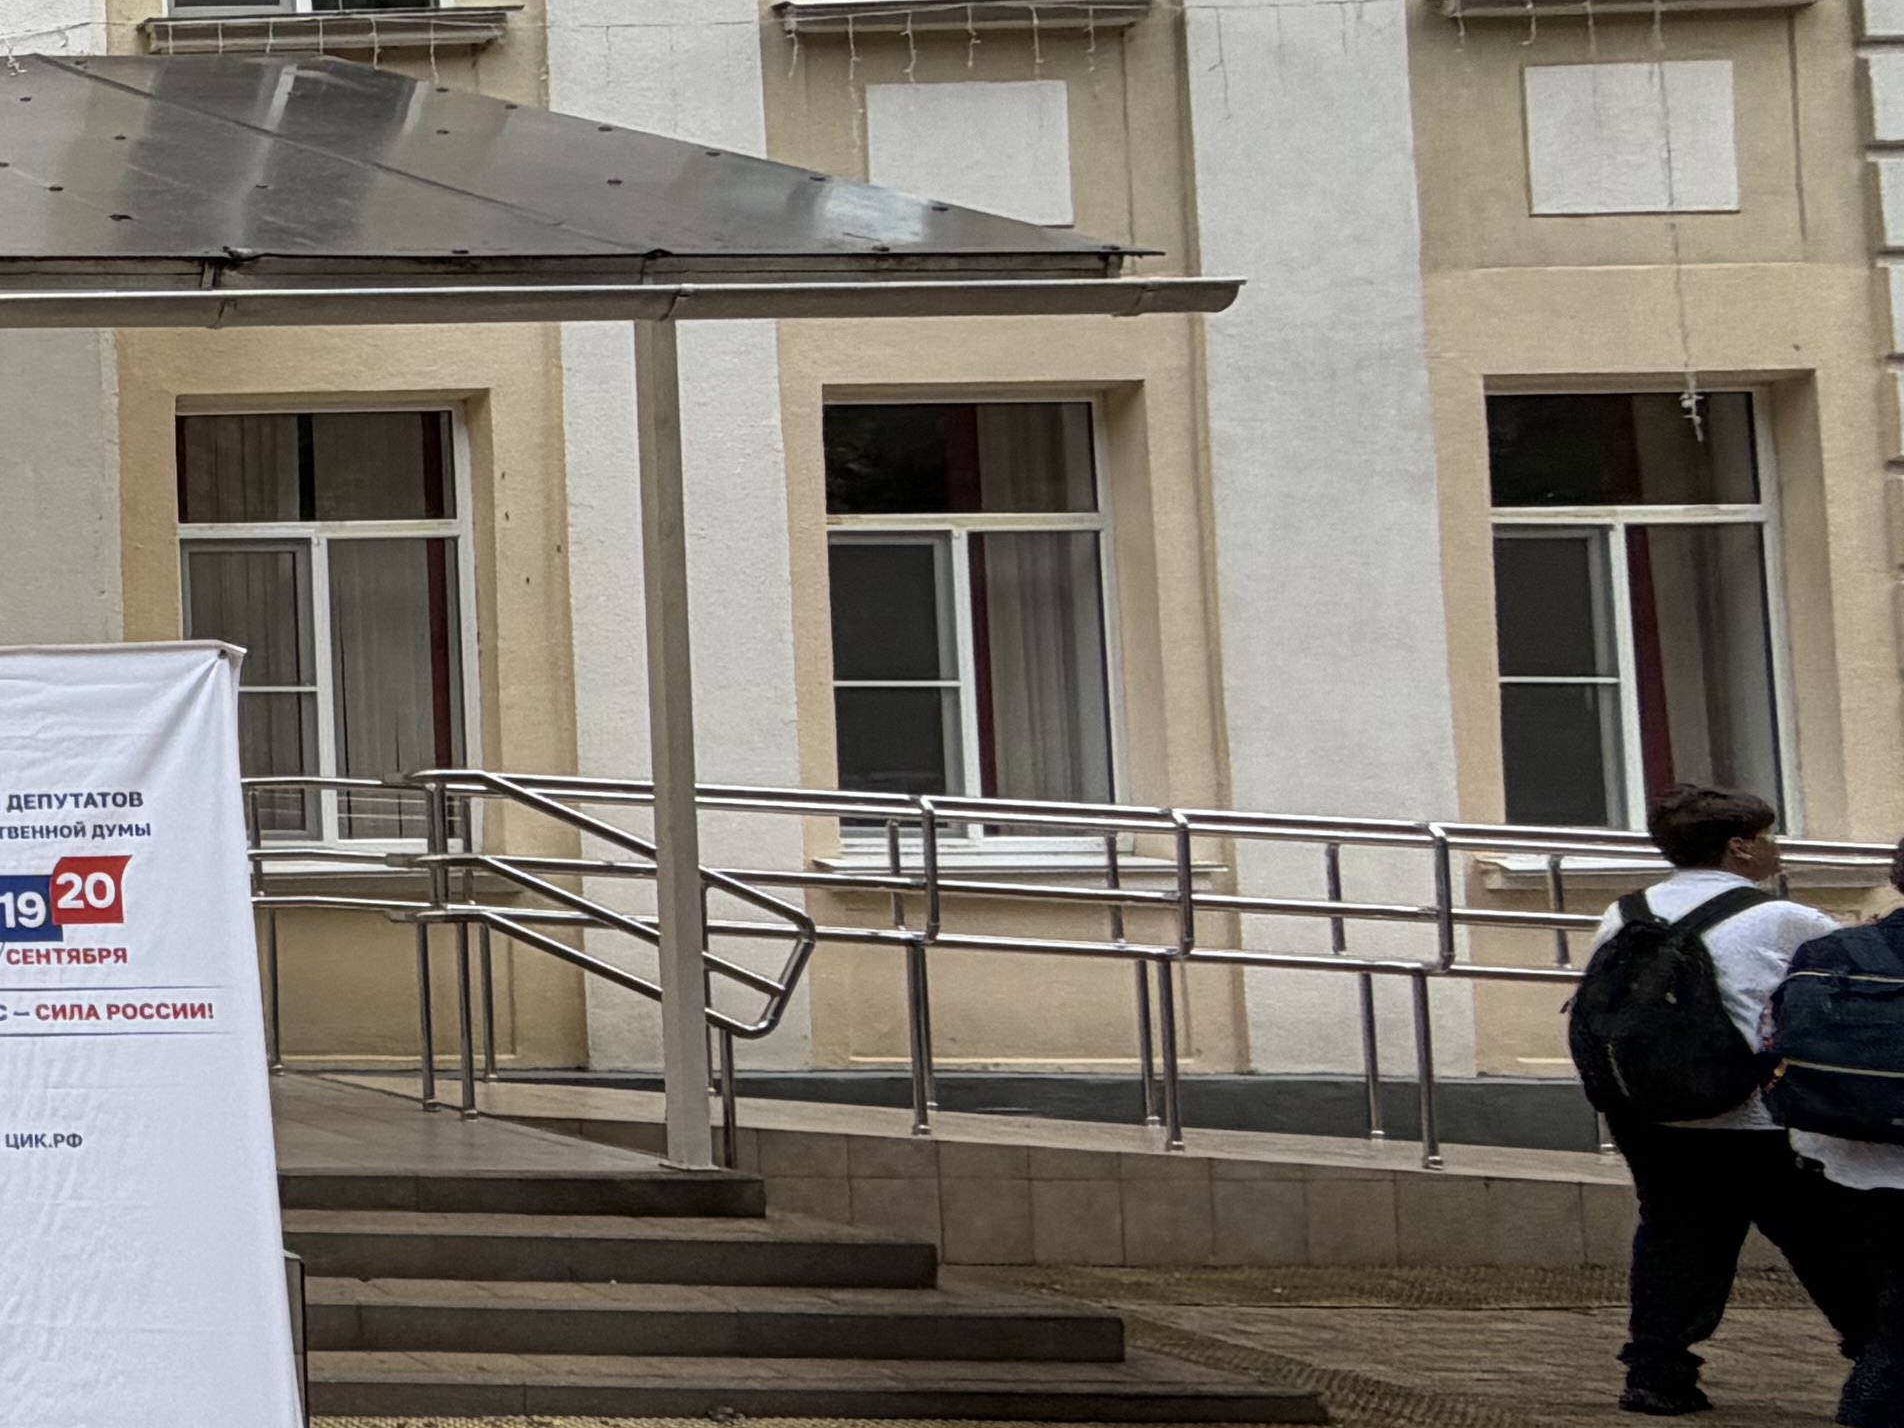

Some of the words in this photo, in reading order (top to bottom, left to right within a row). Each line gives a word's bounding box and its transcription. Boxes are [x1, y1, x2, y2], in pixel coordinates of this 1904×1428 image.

[6, 790, 144, 813] ДЕПУТАТОВ
[91, 822, 152, 841] ДУМЫ
[55, 872, 115, 910] 20
[6, 946, 128, 965] СЕНТЯБРЯ
[35, 1003, 101, 1021] СИЛА
[106, 1002, 214, 1021] РОССИИ!
[4, 1132, 83, 1150] ЦИК.РФ
